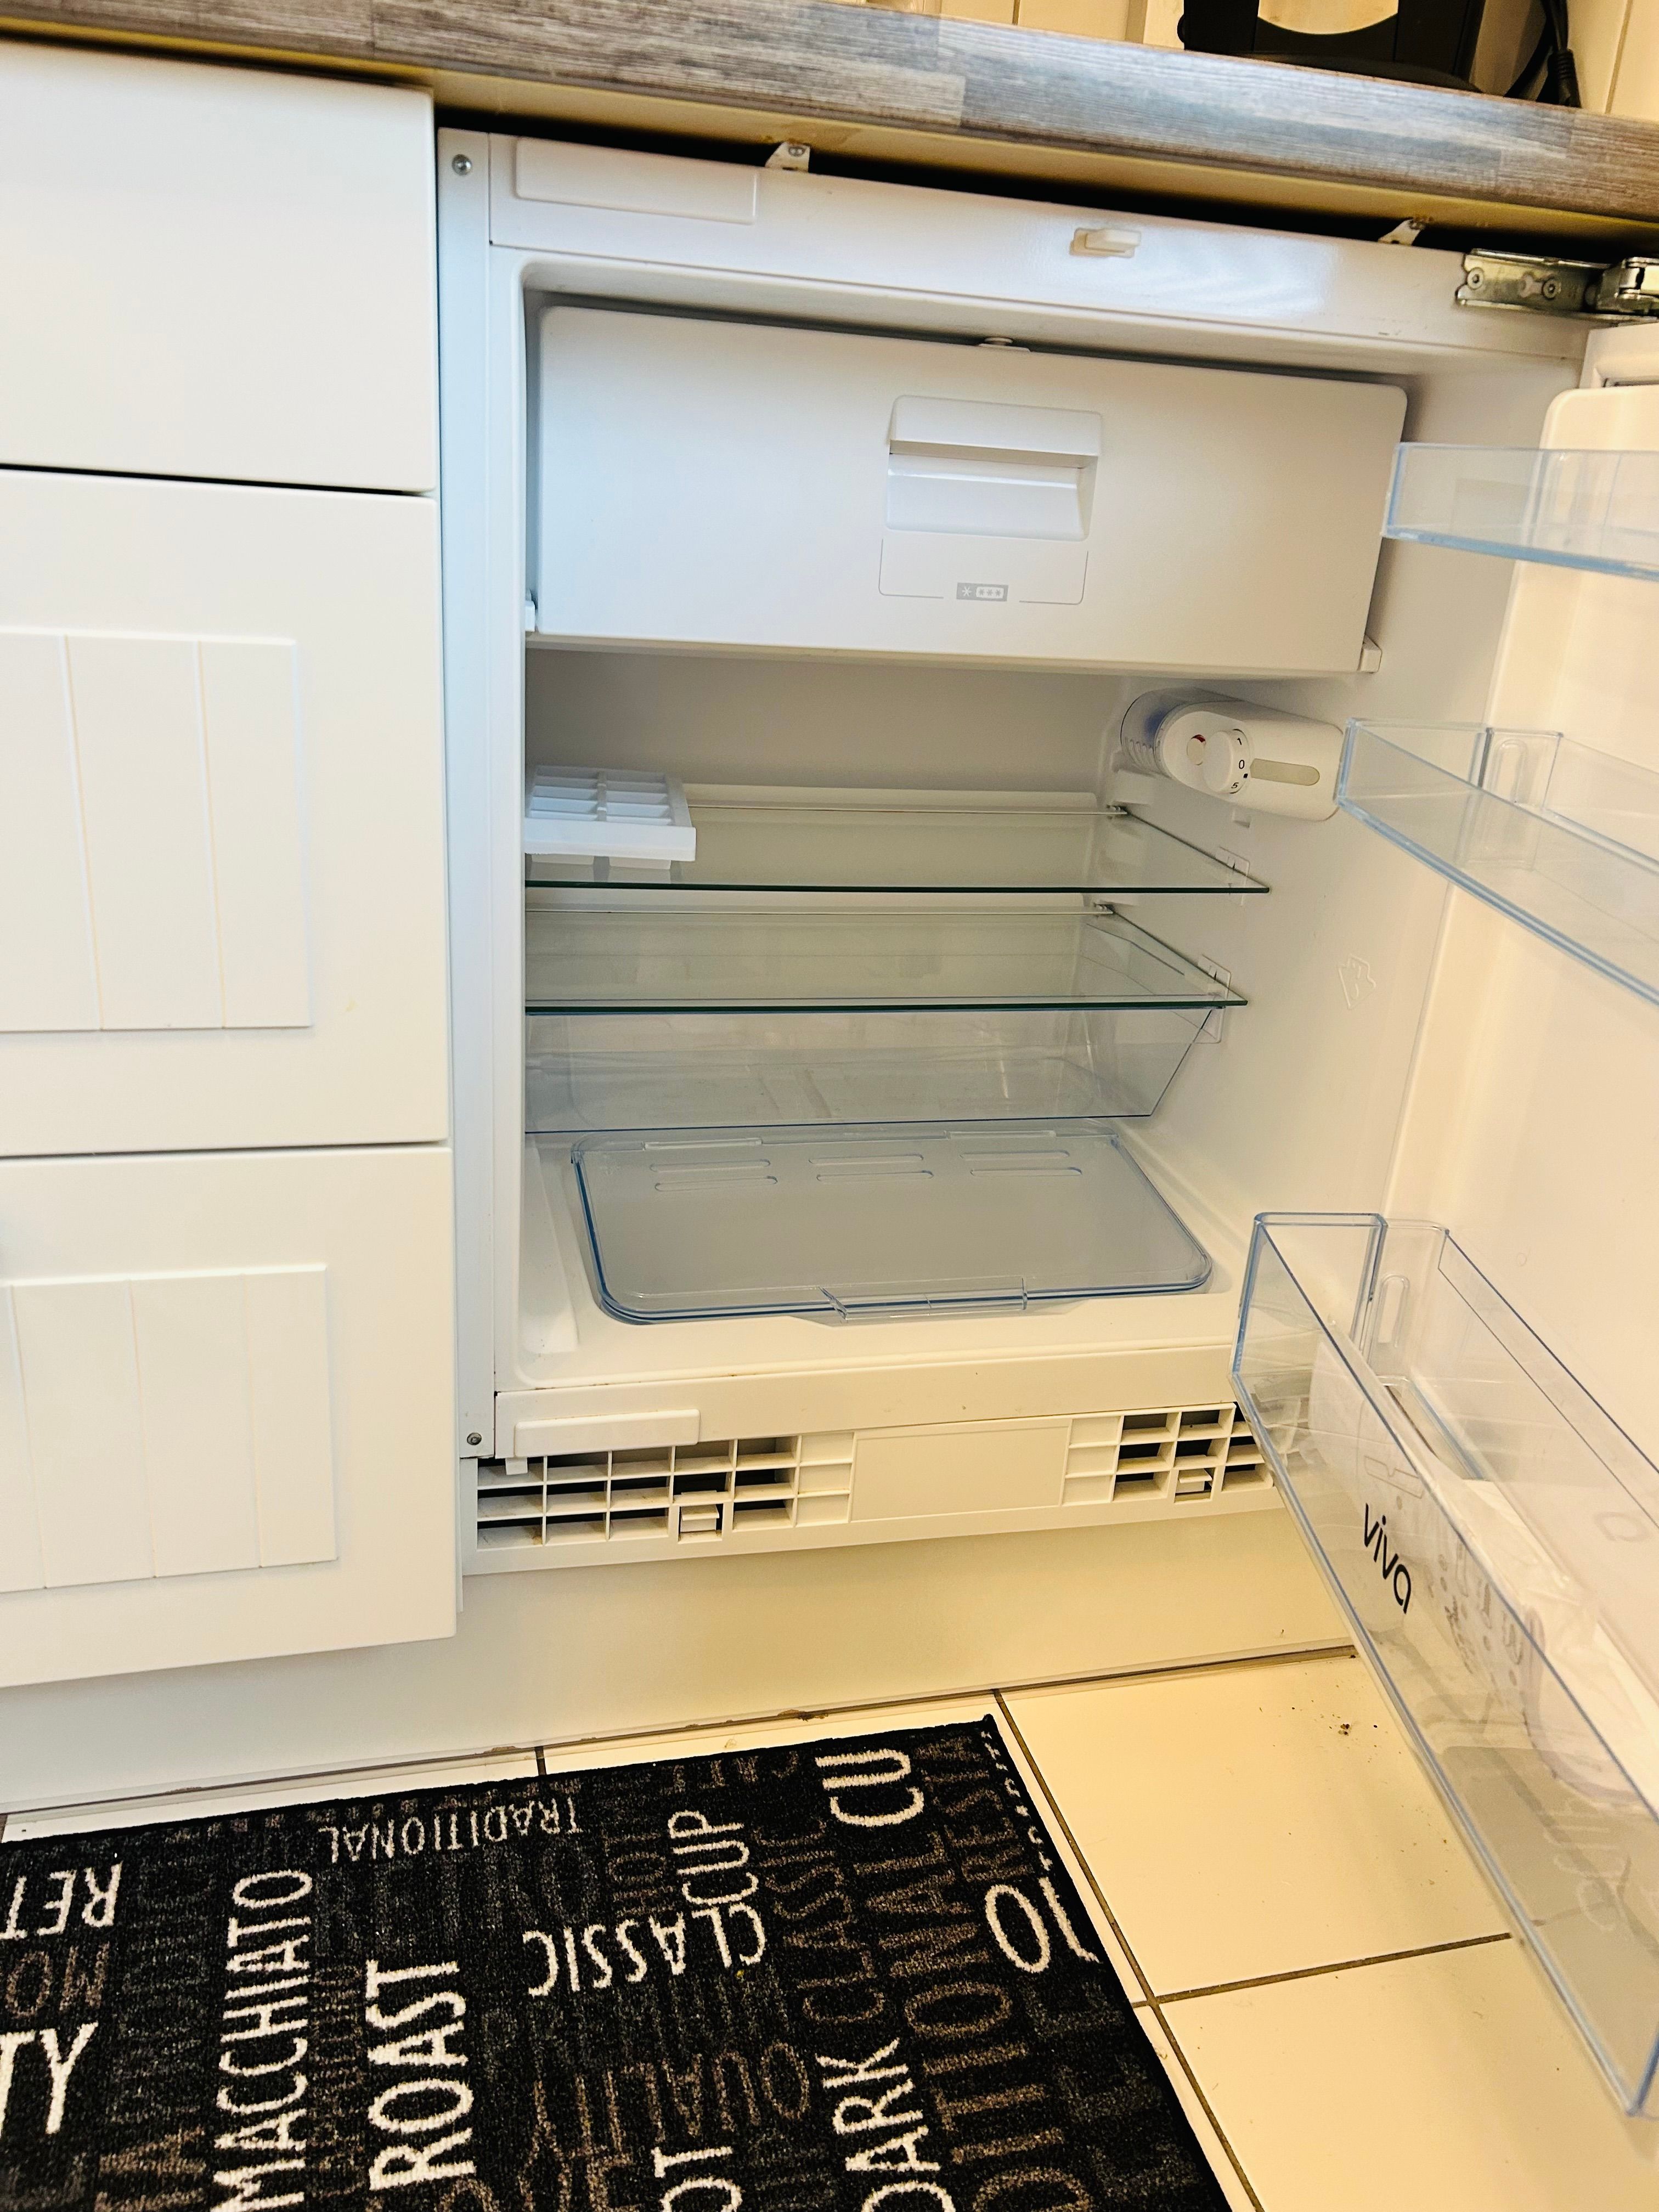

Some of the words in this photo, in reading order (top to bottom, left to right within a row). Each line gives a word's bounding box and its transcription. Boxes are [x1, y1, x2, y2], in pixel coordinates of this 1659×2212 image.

[1239, 760, 1245, 769] 0
[1363, 1503, 1412, 1615] viva
[318, 1796, 584, 1864] TRADITIONAL
[815, 1748, 924, 1827] CU
[0, 1861, 122, 1940] RET
[668, 1810, 759, 1905] CUP
[523, 1903, 766, 1996] CLASSIC
[0, 2022, 99, 2134] TY
[209, 1869, 313, 2212] MACCHIATO
[365, 1959, 477, 2190] ROAST
